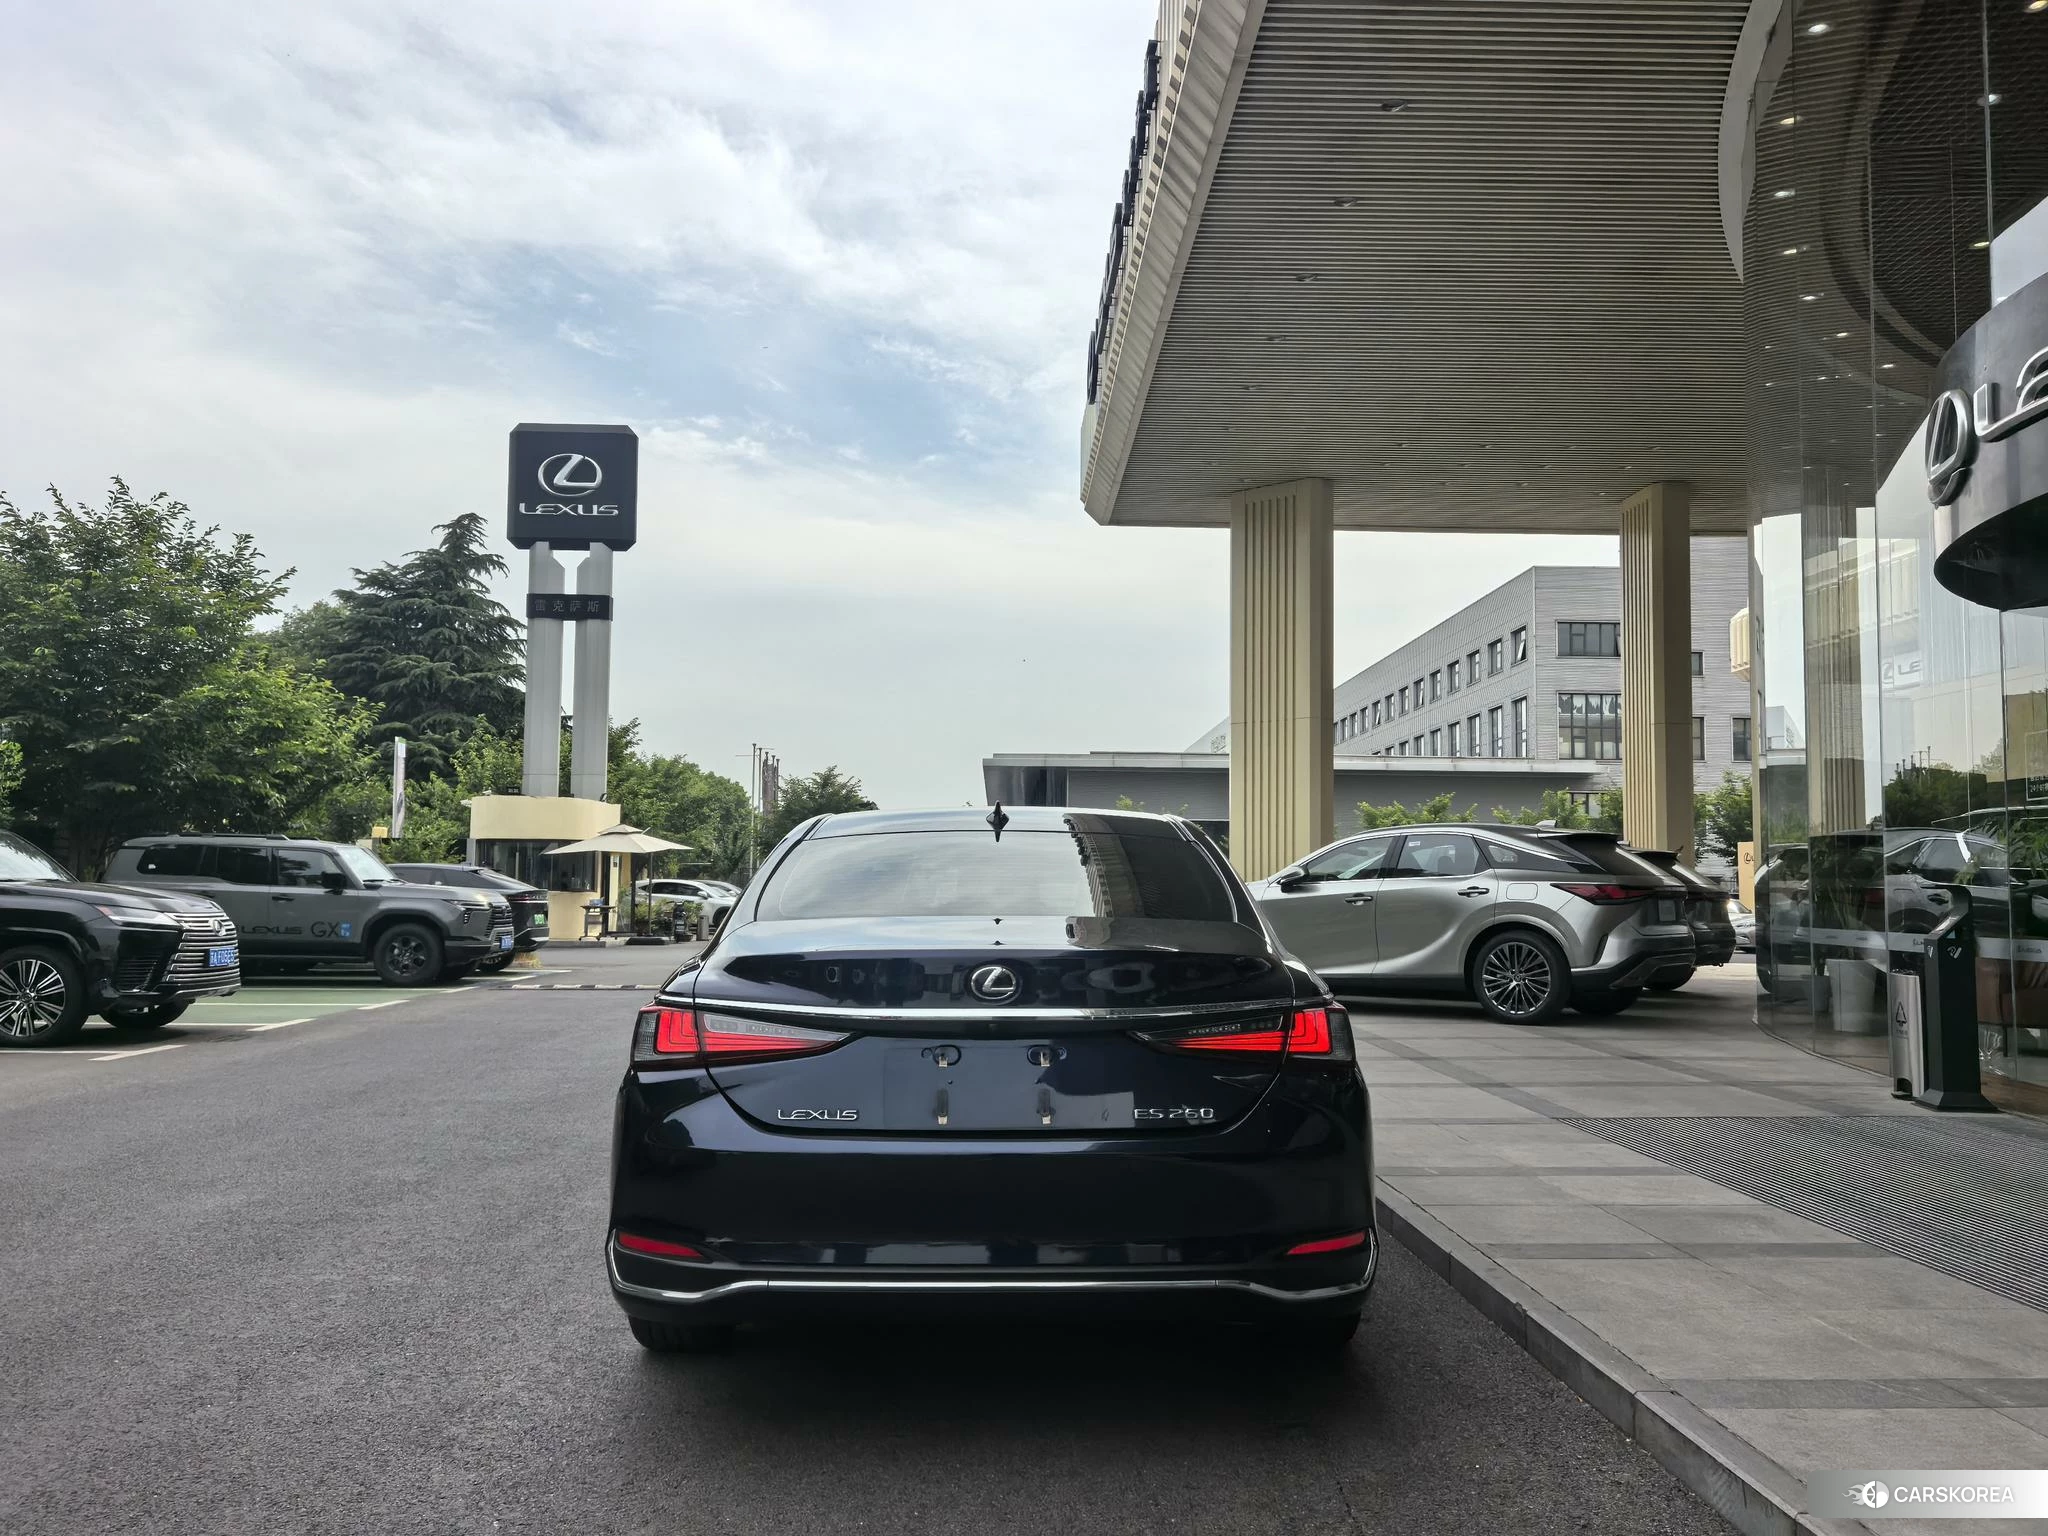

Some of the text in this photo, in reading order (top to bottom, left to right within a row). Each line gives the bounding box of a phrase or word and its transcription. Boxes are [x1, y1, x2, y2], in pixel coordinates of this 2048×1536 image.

[518, 502, 619, 516] LEXUS
[534, 599, 600, 613] 雷克萨斯
[241, 925, 302, 935] LEXUS
[310, 921, 339, 938] GX
[777, 1109, 858, 1121] LEXUS
[1134, 1108, 1214, 1119] ES 260
